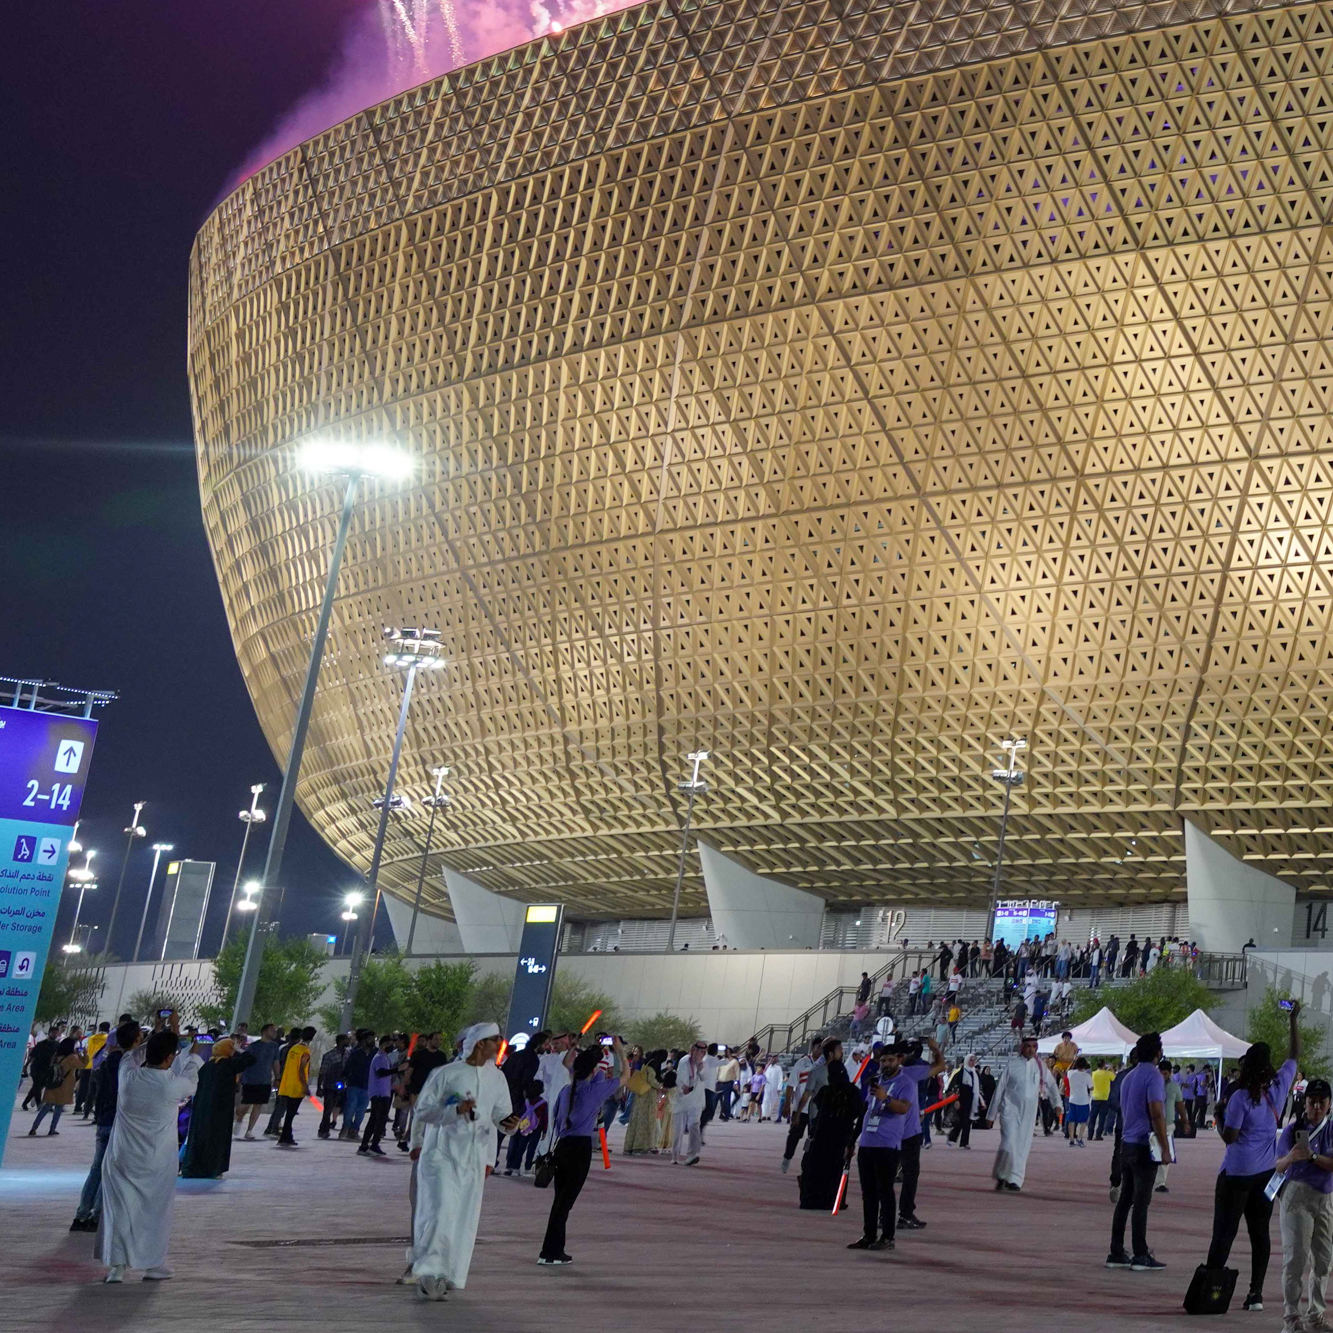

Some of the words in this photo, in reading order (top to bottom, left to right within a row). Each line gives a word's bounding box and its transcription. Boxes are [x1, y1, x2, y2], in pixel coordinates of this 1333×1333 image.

[22, 779, 73, 811] 2-14
[0, 884, 28, 896] olution
[30, 887, 50, 897] Point
[1305, 902, 1328, 939] 14
[11, 922, 42, 934] Storage
[6, 1003, 25, 1012] Area
